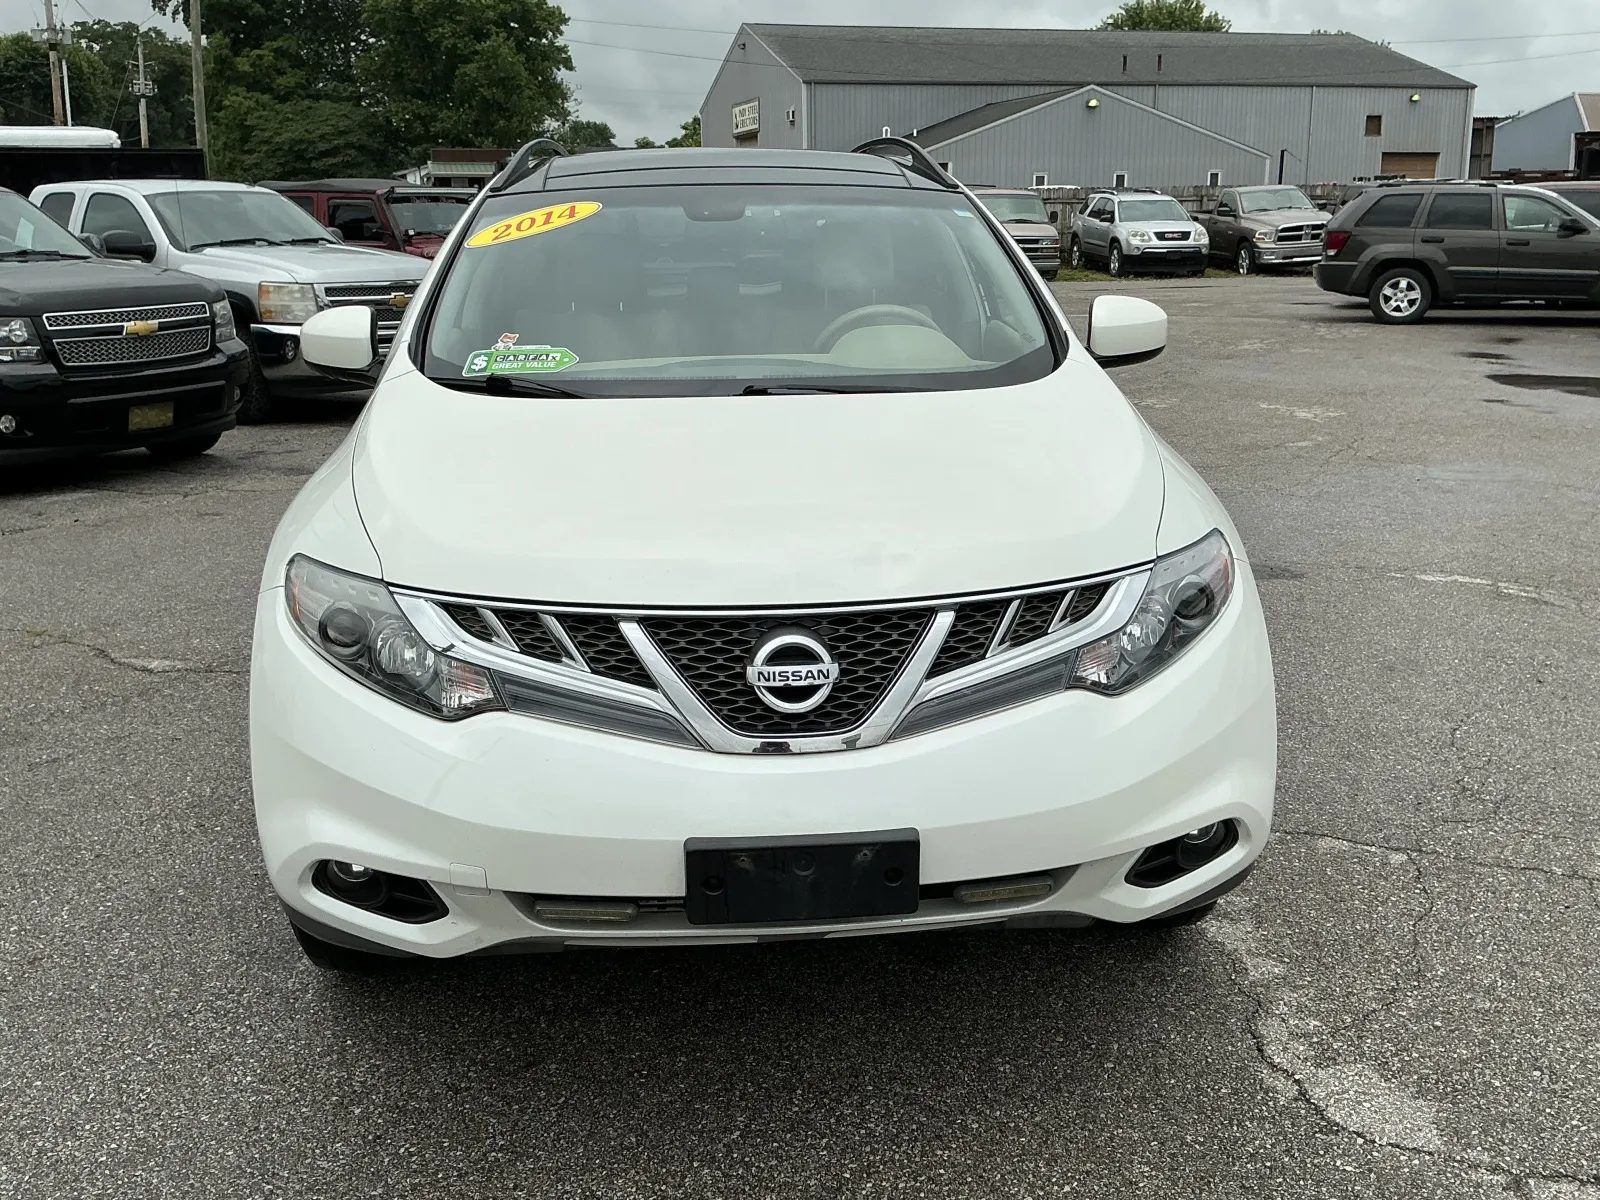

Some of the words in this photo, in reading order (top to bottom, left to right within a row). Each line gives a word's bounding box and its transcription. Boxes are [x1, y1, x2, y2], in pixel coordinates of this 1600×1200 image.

[747, 104, 758, 117] STEEL
[739, 115, 758, 129] ERECTORS
[491, 205, 580, 241] 2014
[495, 353, 560, 362] CARFAX
[491, 361, 522, 370] GREAT
[757, 668, 830, 683] NISSAN
